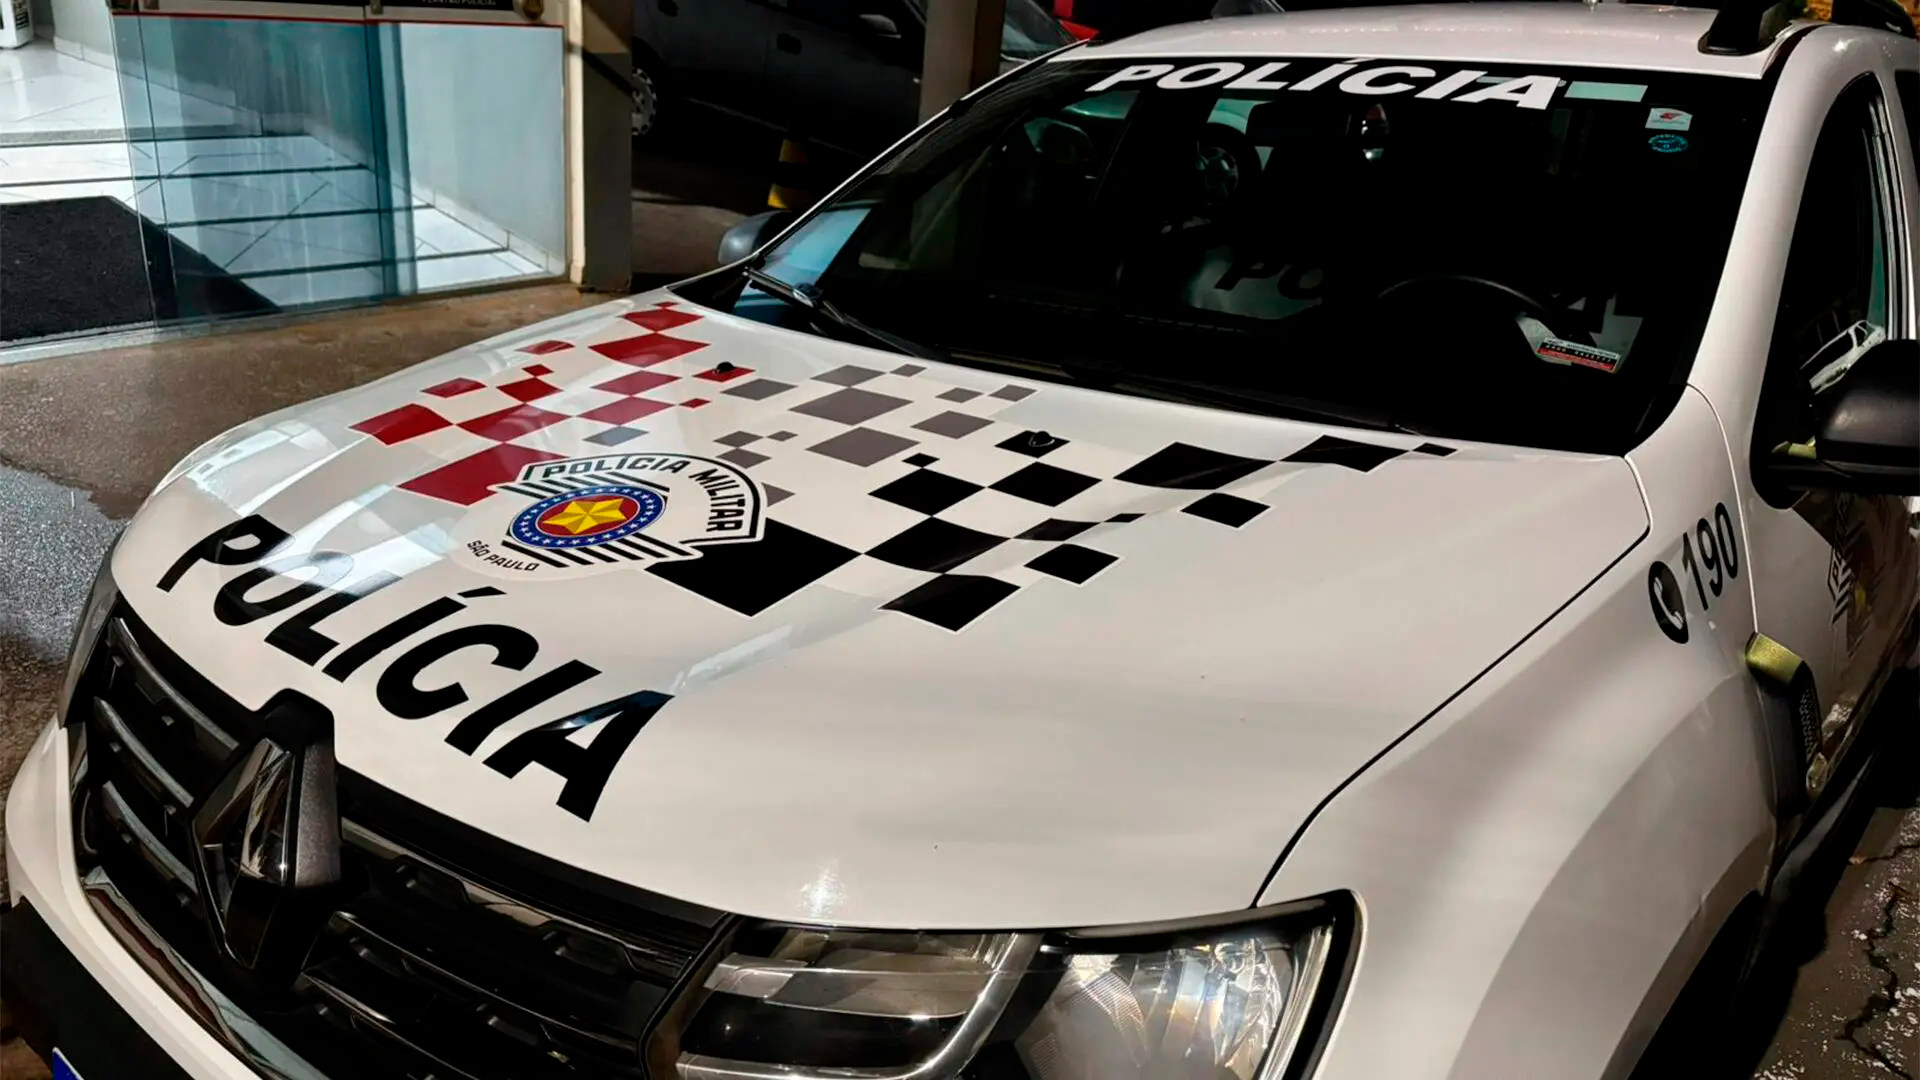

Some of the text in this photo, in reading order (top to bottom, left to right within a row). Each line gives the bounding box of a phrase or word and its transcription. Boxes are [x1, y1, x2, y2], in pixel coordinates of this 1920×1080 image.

[1085, 58, 1562, 110] POLÍCIA
[542, 455, 746, 533] POLÍCIA MILITAR
[467, 540, 540, 571] SÃO PAULO
[1682, 502, 1738, 611] 190
[156, 514, 676, 823] POLÍCIA
